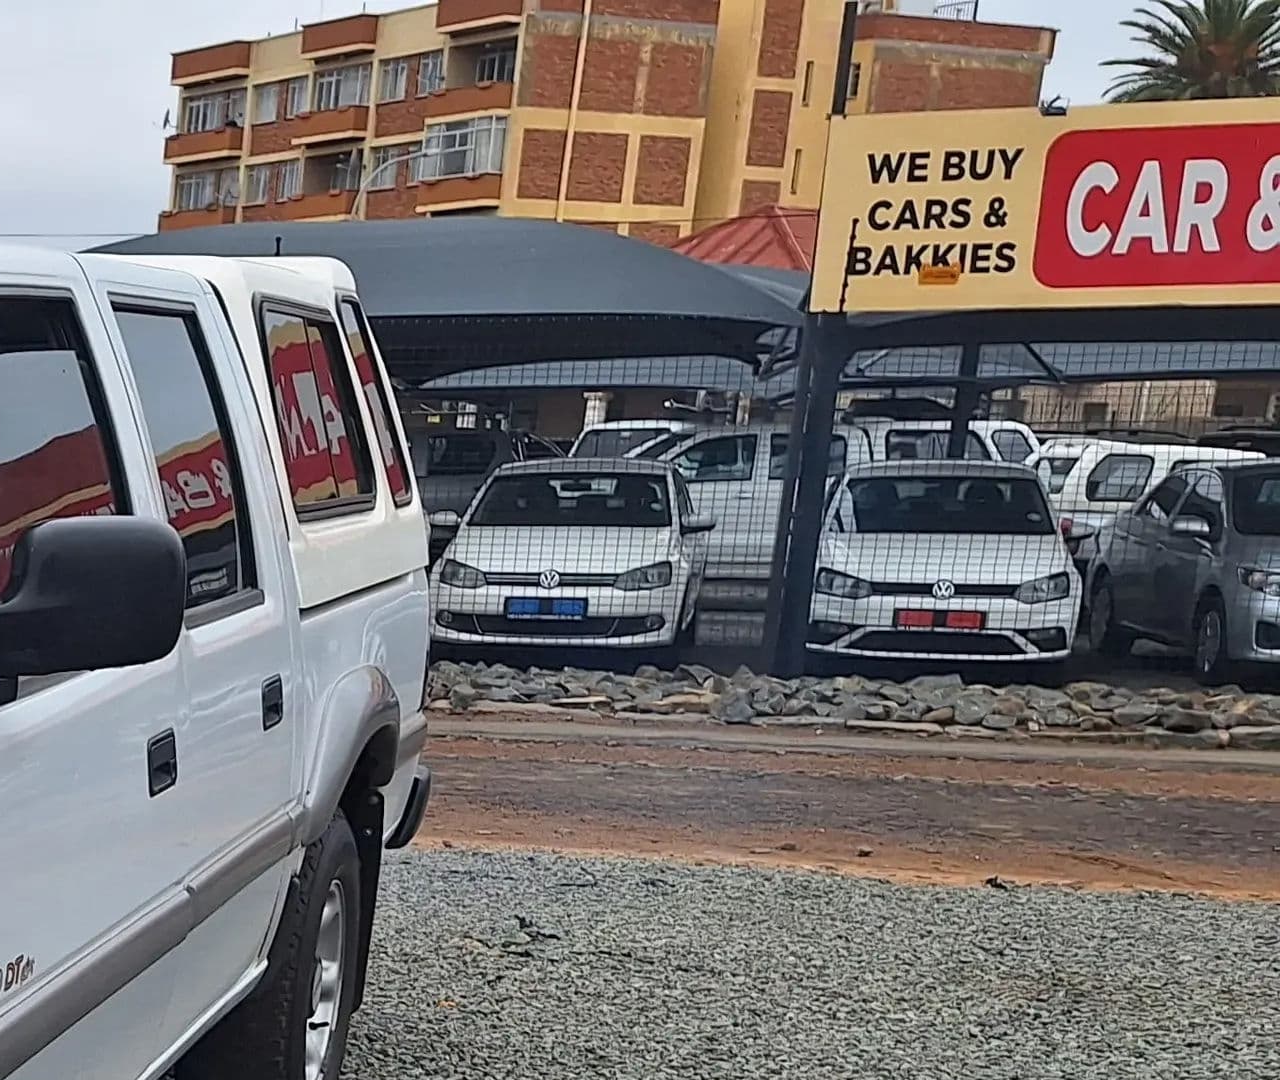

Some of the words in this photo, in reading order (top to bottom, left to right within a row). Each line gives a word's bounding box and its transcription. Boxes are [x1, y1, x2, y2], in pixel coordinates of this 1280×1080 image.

[868, 152, 930, 184] WE
[941, 148, 1024, 181] BUY
[867, 198, 971, 231] CARS
[983, 197, 1008, 228] &
[1066, 158, 1229, 257] CAR
[847, 242, 1017, 276] BAKKIES
